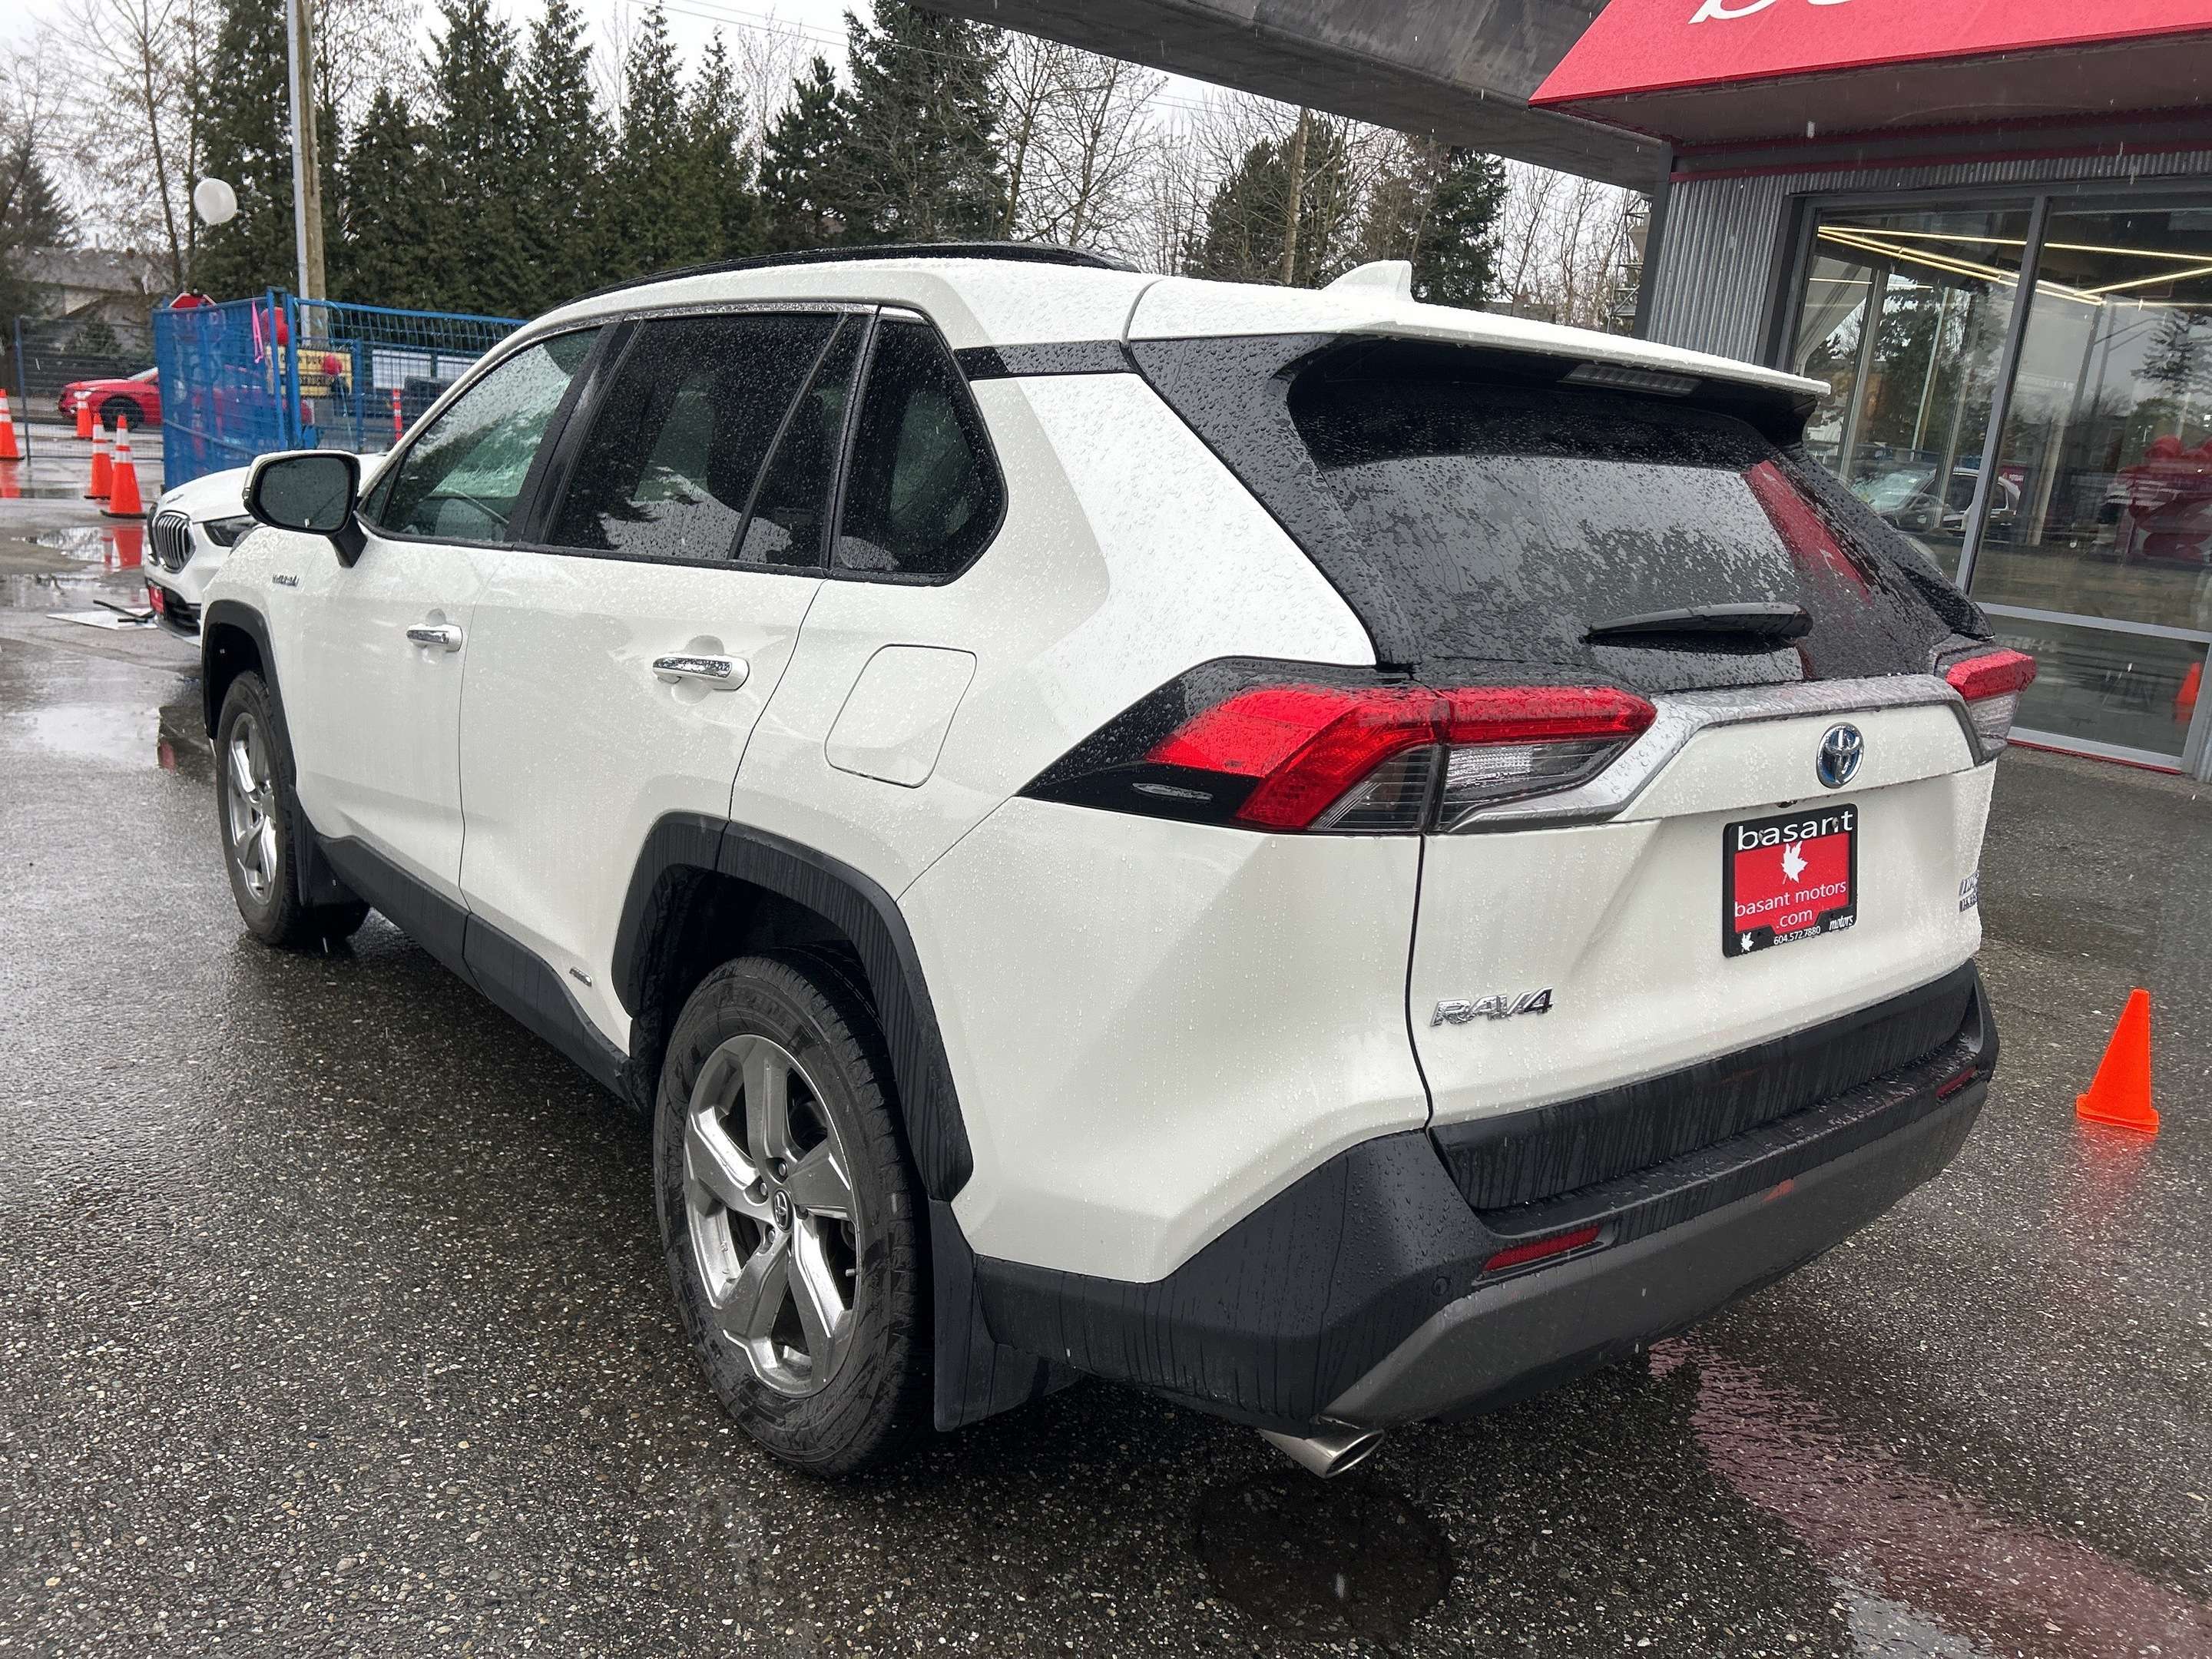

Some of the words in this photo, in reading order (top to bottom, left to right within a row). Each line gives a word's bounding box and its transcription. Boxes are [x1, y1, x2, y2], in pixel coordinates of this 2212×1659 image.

[1737, 810, 1853, 851] basant
[1734, 892, 1790, 917] basant
[1795, 881, 1846, 902] motors
[1776, 909, 1813, 929] .com
[1829, 915, 1853, 931] motors
[1773, 926, 1821, 945] 604.572.7880
[1429, 986, 1554, 1027] RAV4
